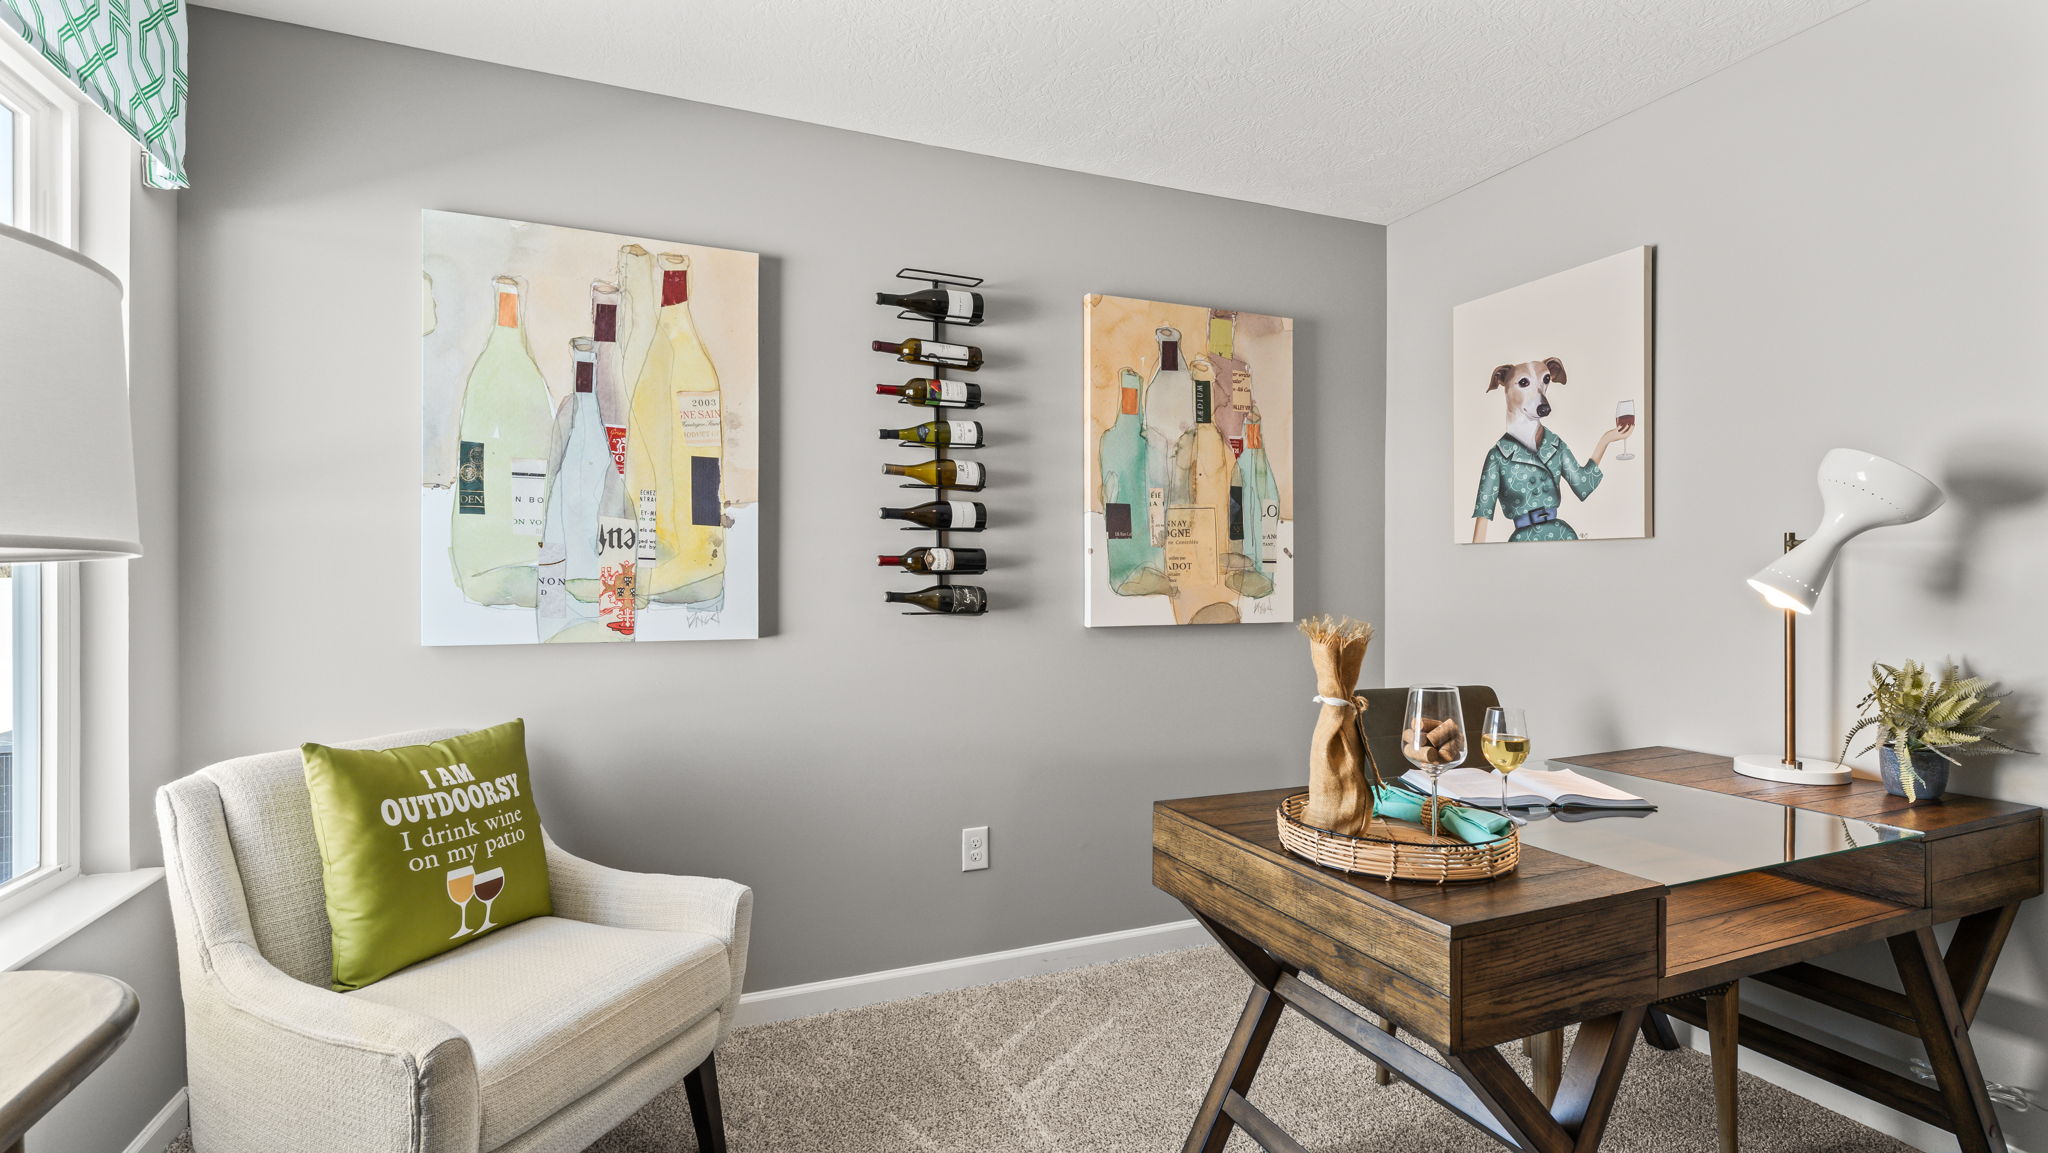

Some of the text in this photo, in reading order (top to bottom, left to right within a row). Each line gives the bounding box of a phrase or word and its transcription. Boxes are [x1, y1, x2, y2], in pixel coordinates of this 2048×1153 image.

[691, 399, 717, 407] 2003
[459, 494, 484, 504] DEN
[419, 762, 476, 790] I AM
[380, 773, 521, 827] OUTDOORSY
[400, 808, 523, 852] I drink wine
[408, 826, 526, 872] on my patio
